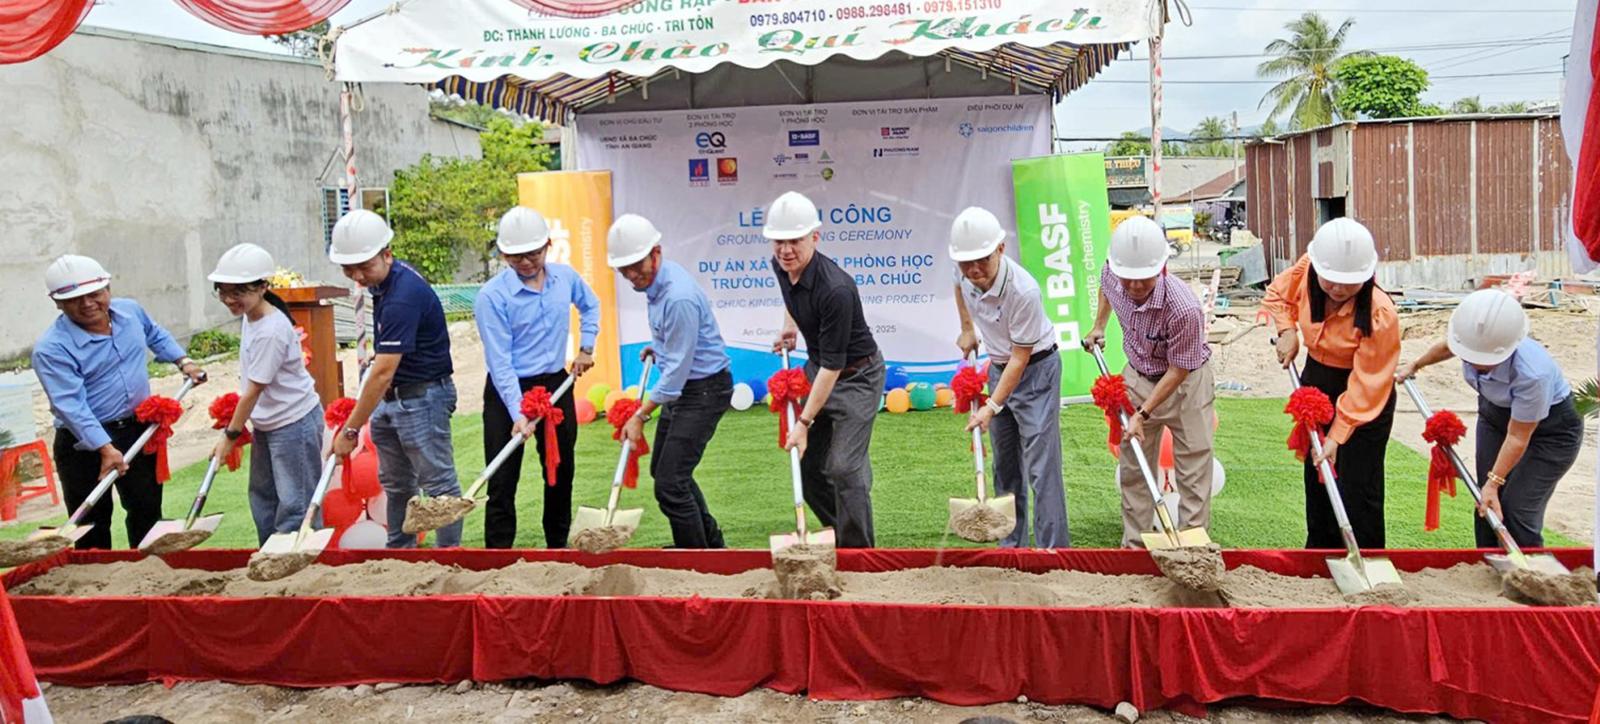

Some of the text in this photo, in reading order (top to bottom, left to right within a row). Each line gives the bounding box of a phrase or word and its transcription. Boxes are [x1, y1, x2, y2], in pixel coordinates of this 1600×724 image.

[750, 9, 826, 27] 0979.804710
[836, 3, 912, 20] 0988.298481
[923, 0, 1002, 13] 0979.151310
[483, 30, 503, 42] ĐC:
[601, 25, 617, 36] BA
[665, 20, 684, 32] TRI
[687, 15, 714, 31] TÔN
[578, 38, 731, 65] Chào
[755, 25, 867, 55] Quí
[882, 8, 1109, 45] Khách
[977, 123, 1034, 134] saigonchildren
[738, 206, 764, 228] LỄ
[829, 203, 892, 225] CÔNG
[838, 228, 913, 242] CEREMONY
[1078, 199, 1095, 271] chemistry
[1038, 202, 1076, 299] BASF
[698, 260, 721, 275] DỰ
[724, 257, 745, 272] ÁN
[750, 256, 769, 272] XÂ
[843, 252, 897, 268] PHÒNG
[901, 254, 934, 270] HỌC
[711, 270, 923, 290] TRƯỜNG BA CHÚC
[885, 294, 936, 304] PROJECT
[875, 325, 897, 334] 2025
